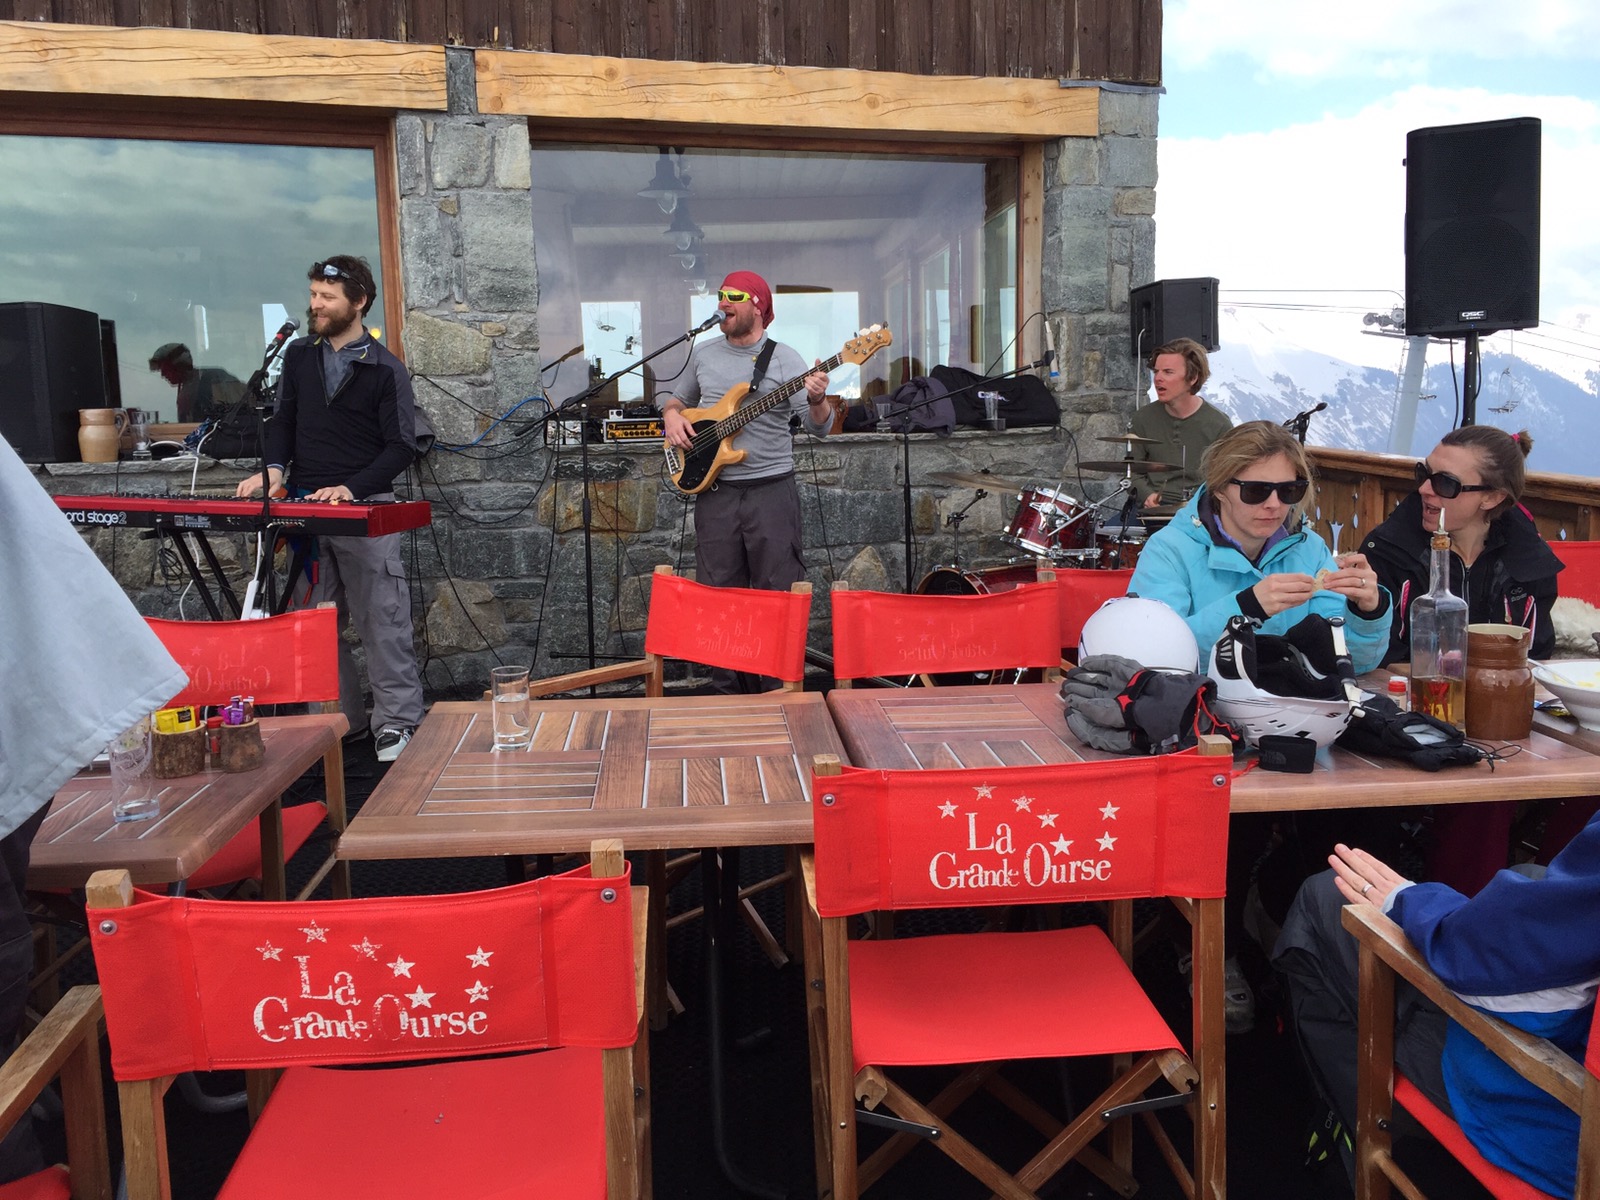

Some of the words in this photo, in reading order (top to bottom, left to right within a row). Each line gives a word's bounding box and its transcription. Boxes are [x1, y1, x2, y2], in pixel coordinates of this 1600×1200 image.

[64, 511, 85, 522] ord
[965, 812, 1016, 854] La
[929, 851, 1020, 890] Grande
[1023, 842, 1112, 887] Ourse
[293, 955, 361, 1006] La
[253, 996, 373, 1042] Grande
[373, 994, 488, 1041] Ourse
